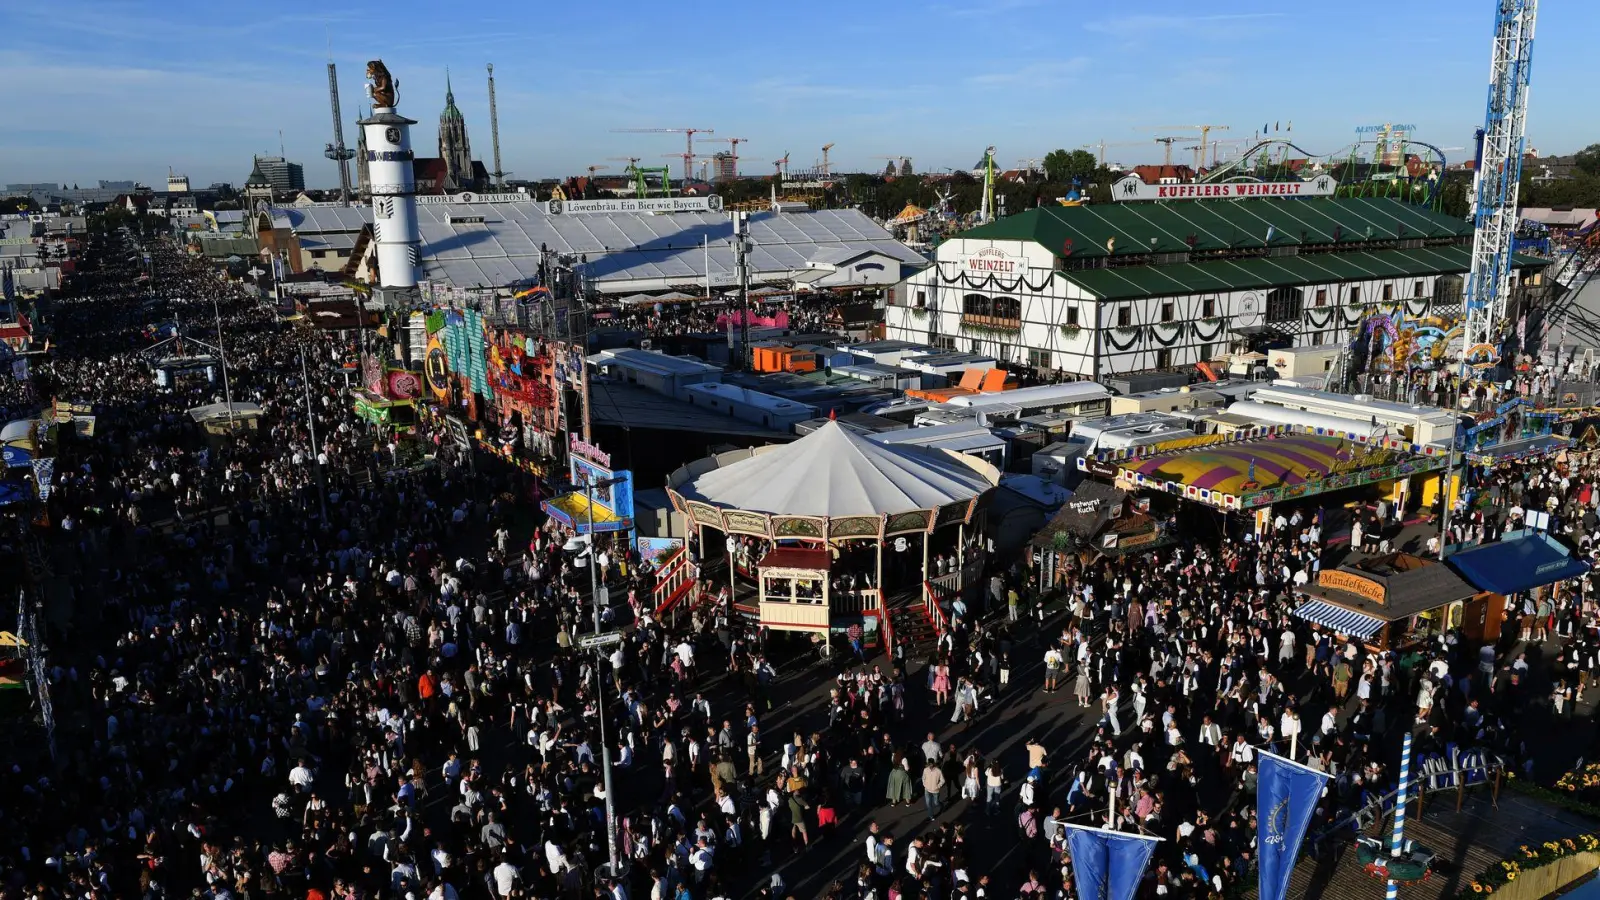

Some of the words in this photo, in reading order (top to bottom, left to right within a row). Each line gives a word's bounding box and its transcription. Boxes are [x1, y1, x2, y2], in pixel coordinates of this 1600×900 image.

[1159, 184, 1230, 198] KUFFLERS
[1236, 183, 1301, 197] WEINZELT
[415, 196, 455, 204] SCHORR
[568, 201, 619, 212] Löwenbräu.
[621, 200, 636, 210] Ein
[638, 200, 655, 210] Bier
[657, 200, 671, 209] wie
[673, 199, 704, 211] Bayern.
[969, 259, 1015, 272] WEINZELT
[1069, 498, 1100, 509] Bratwurst
[1320, 573, 1383, 599] Mandelküche
